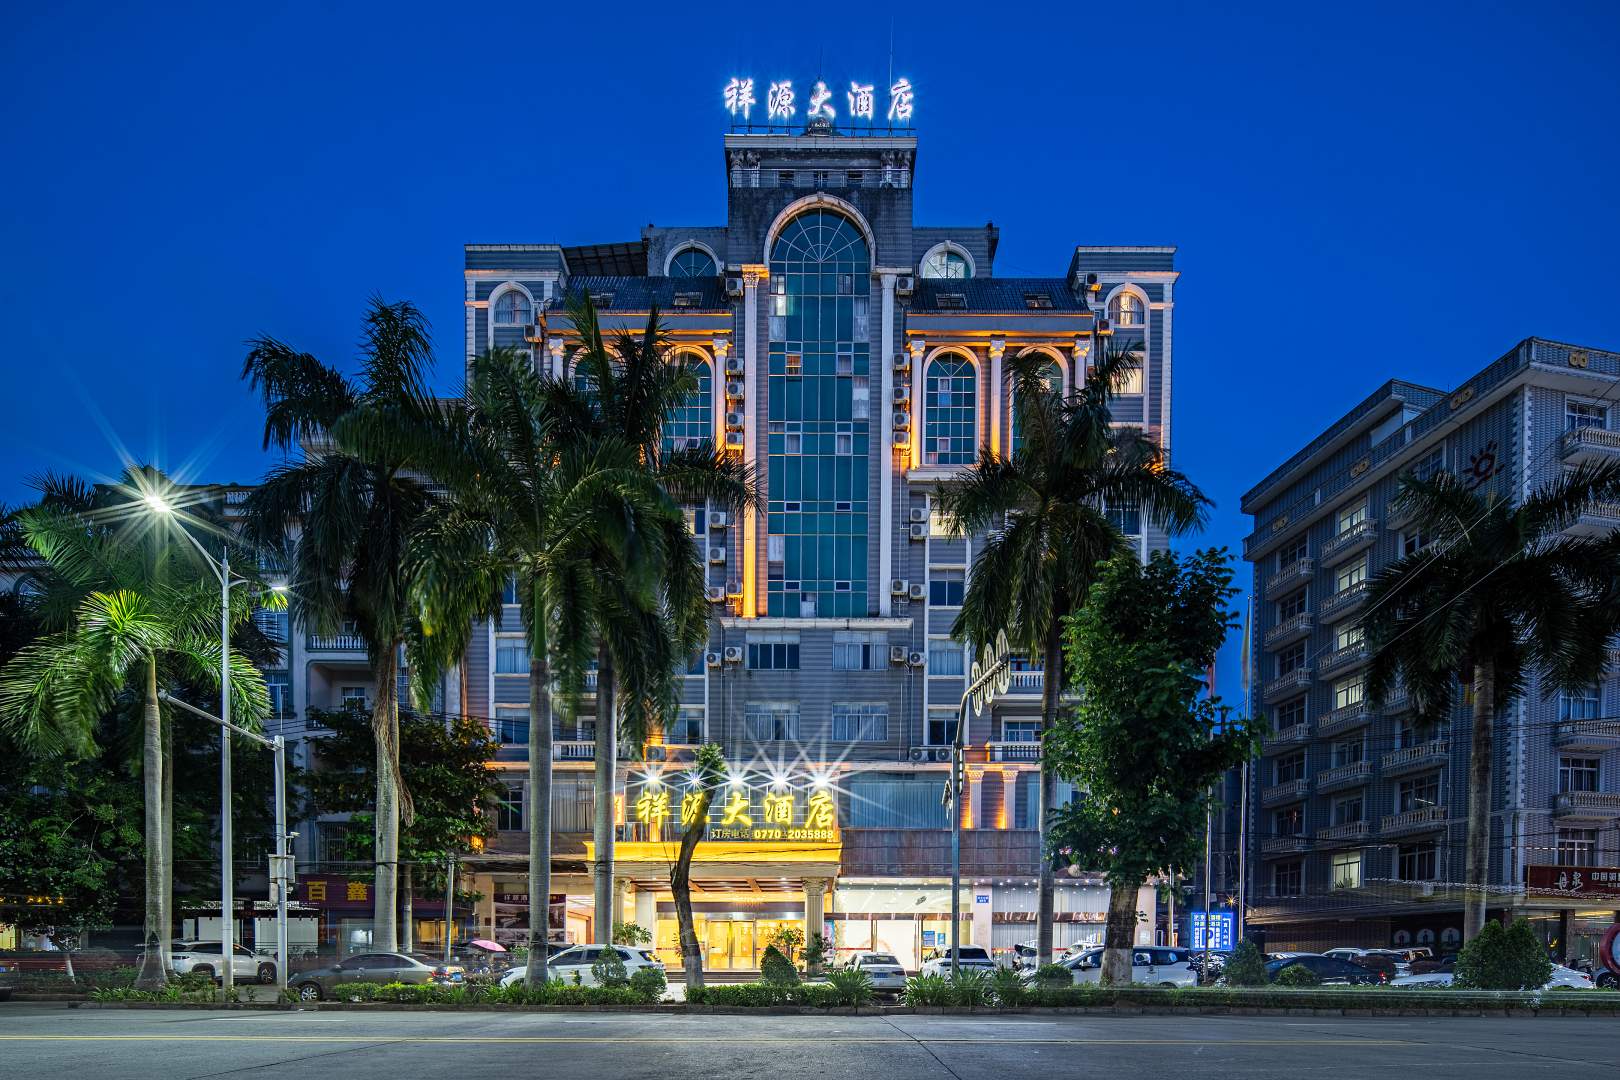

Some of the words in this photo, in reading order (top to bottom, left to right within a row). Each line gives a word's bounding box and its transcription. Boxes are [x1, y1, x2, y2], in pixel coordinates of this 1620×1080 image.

[724, 78, 914, 120] 祥源大酒店
